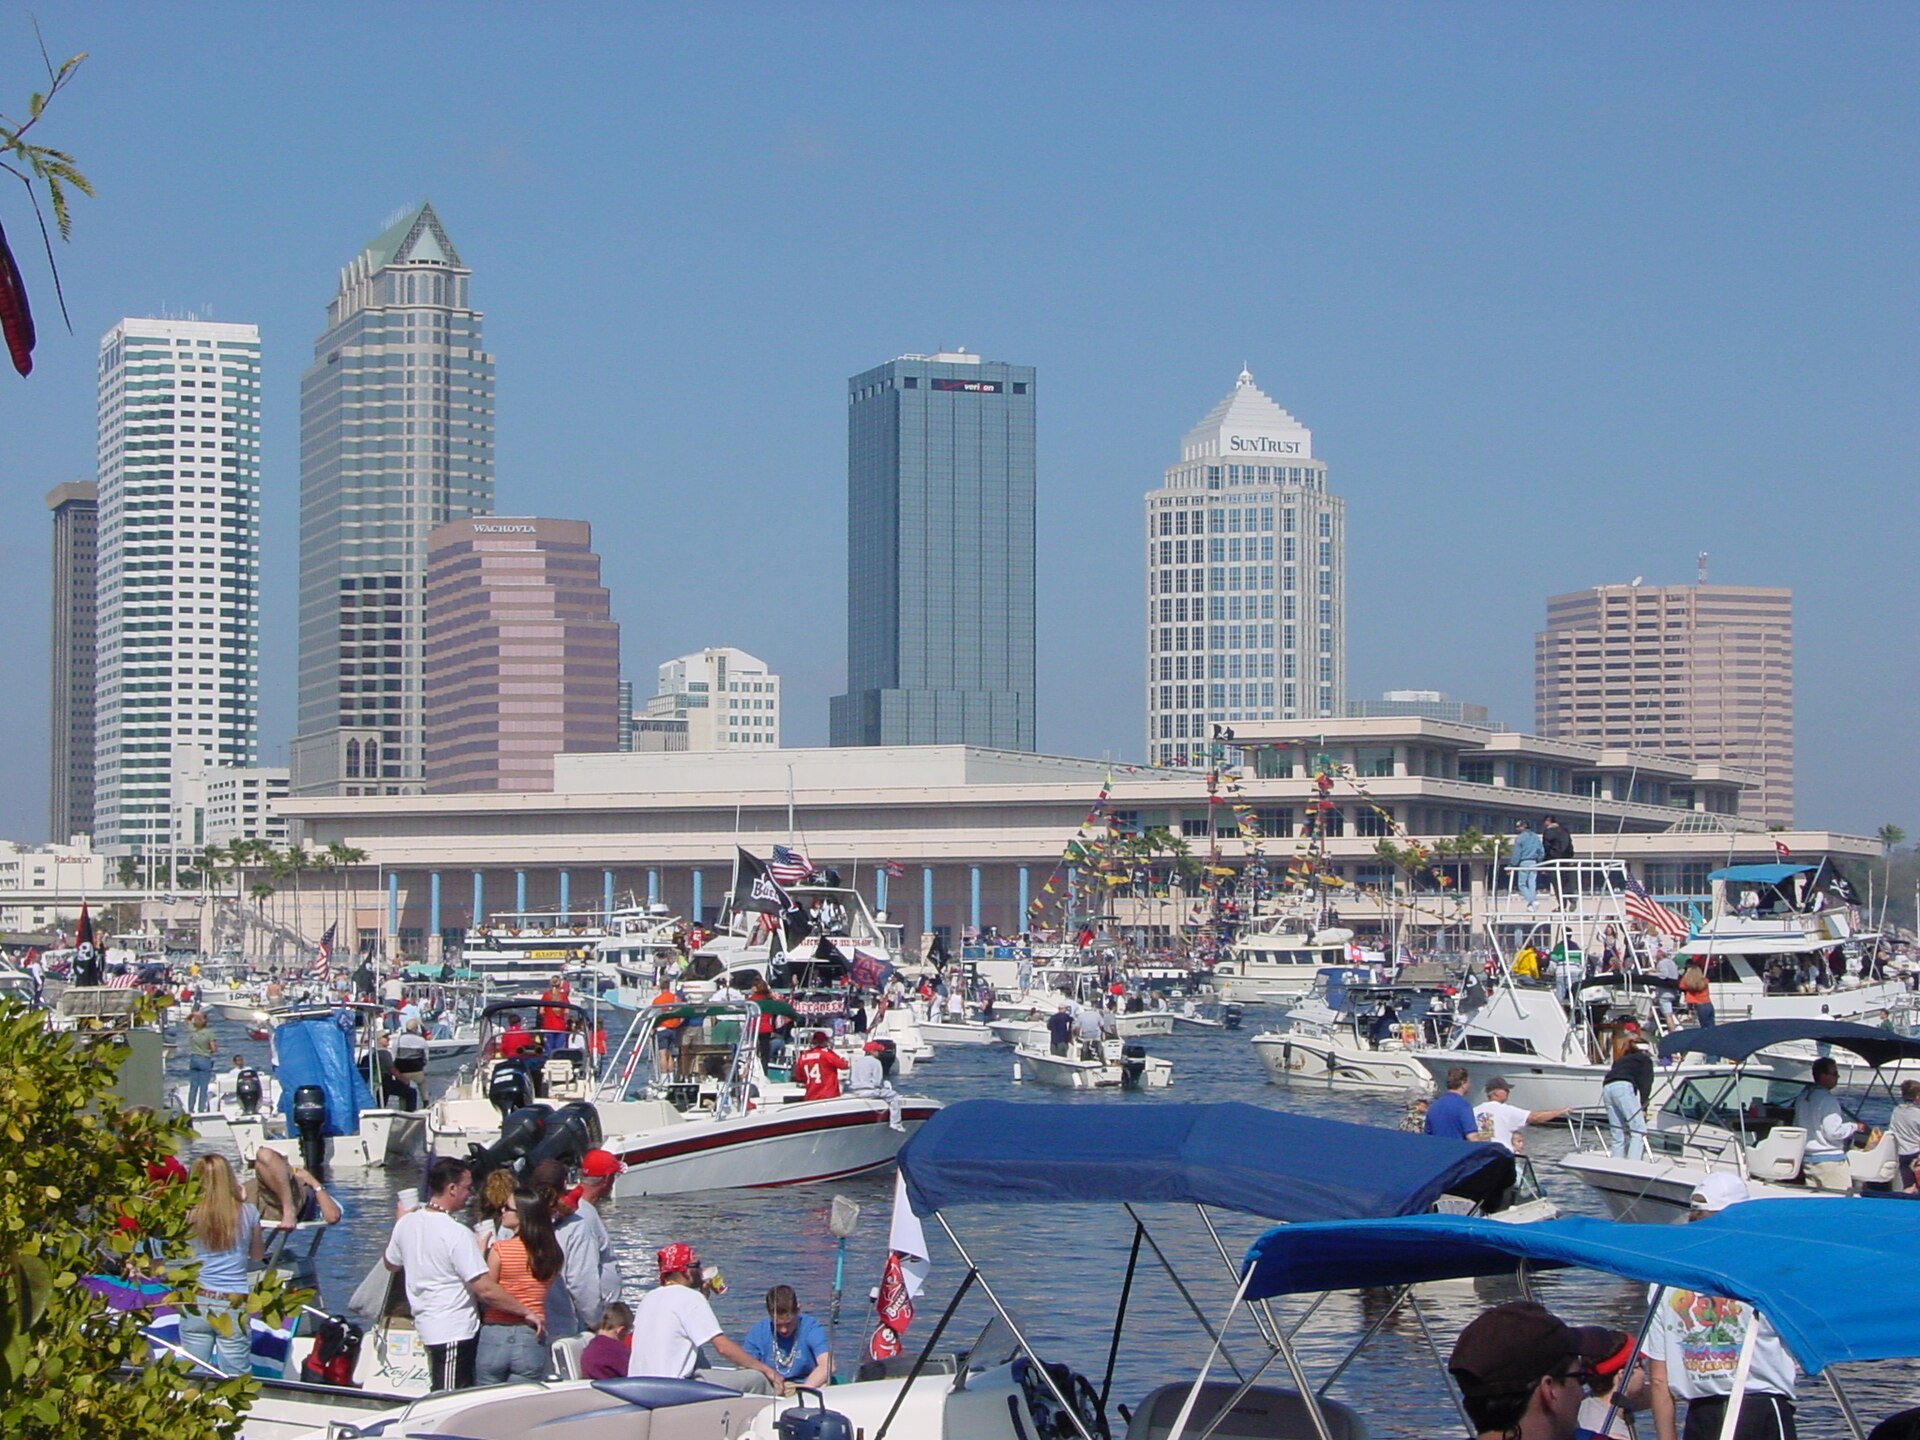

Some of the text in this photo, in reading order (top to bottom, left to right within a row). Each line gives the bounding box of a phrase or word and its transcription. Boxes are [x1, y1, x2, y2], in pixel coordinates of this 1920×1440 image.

[964, 382, 994, 391] verion
[473, 524, 536, 533] WACHOVIA
[54, 855, 92, 864] Radisson
[804, 1063, 821, 1084] 14
